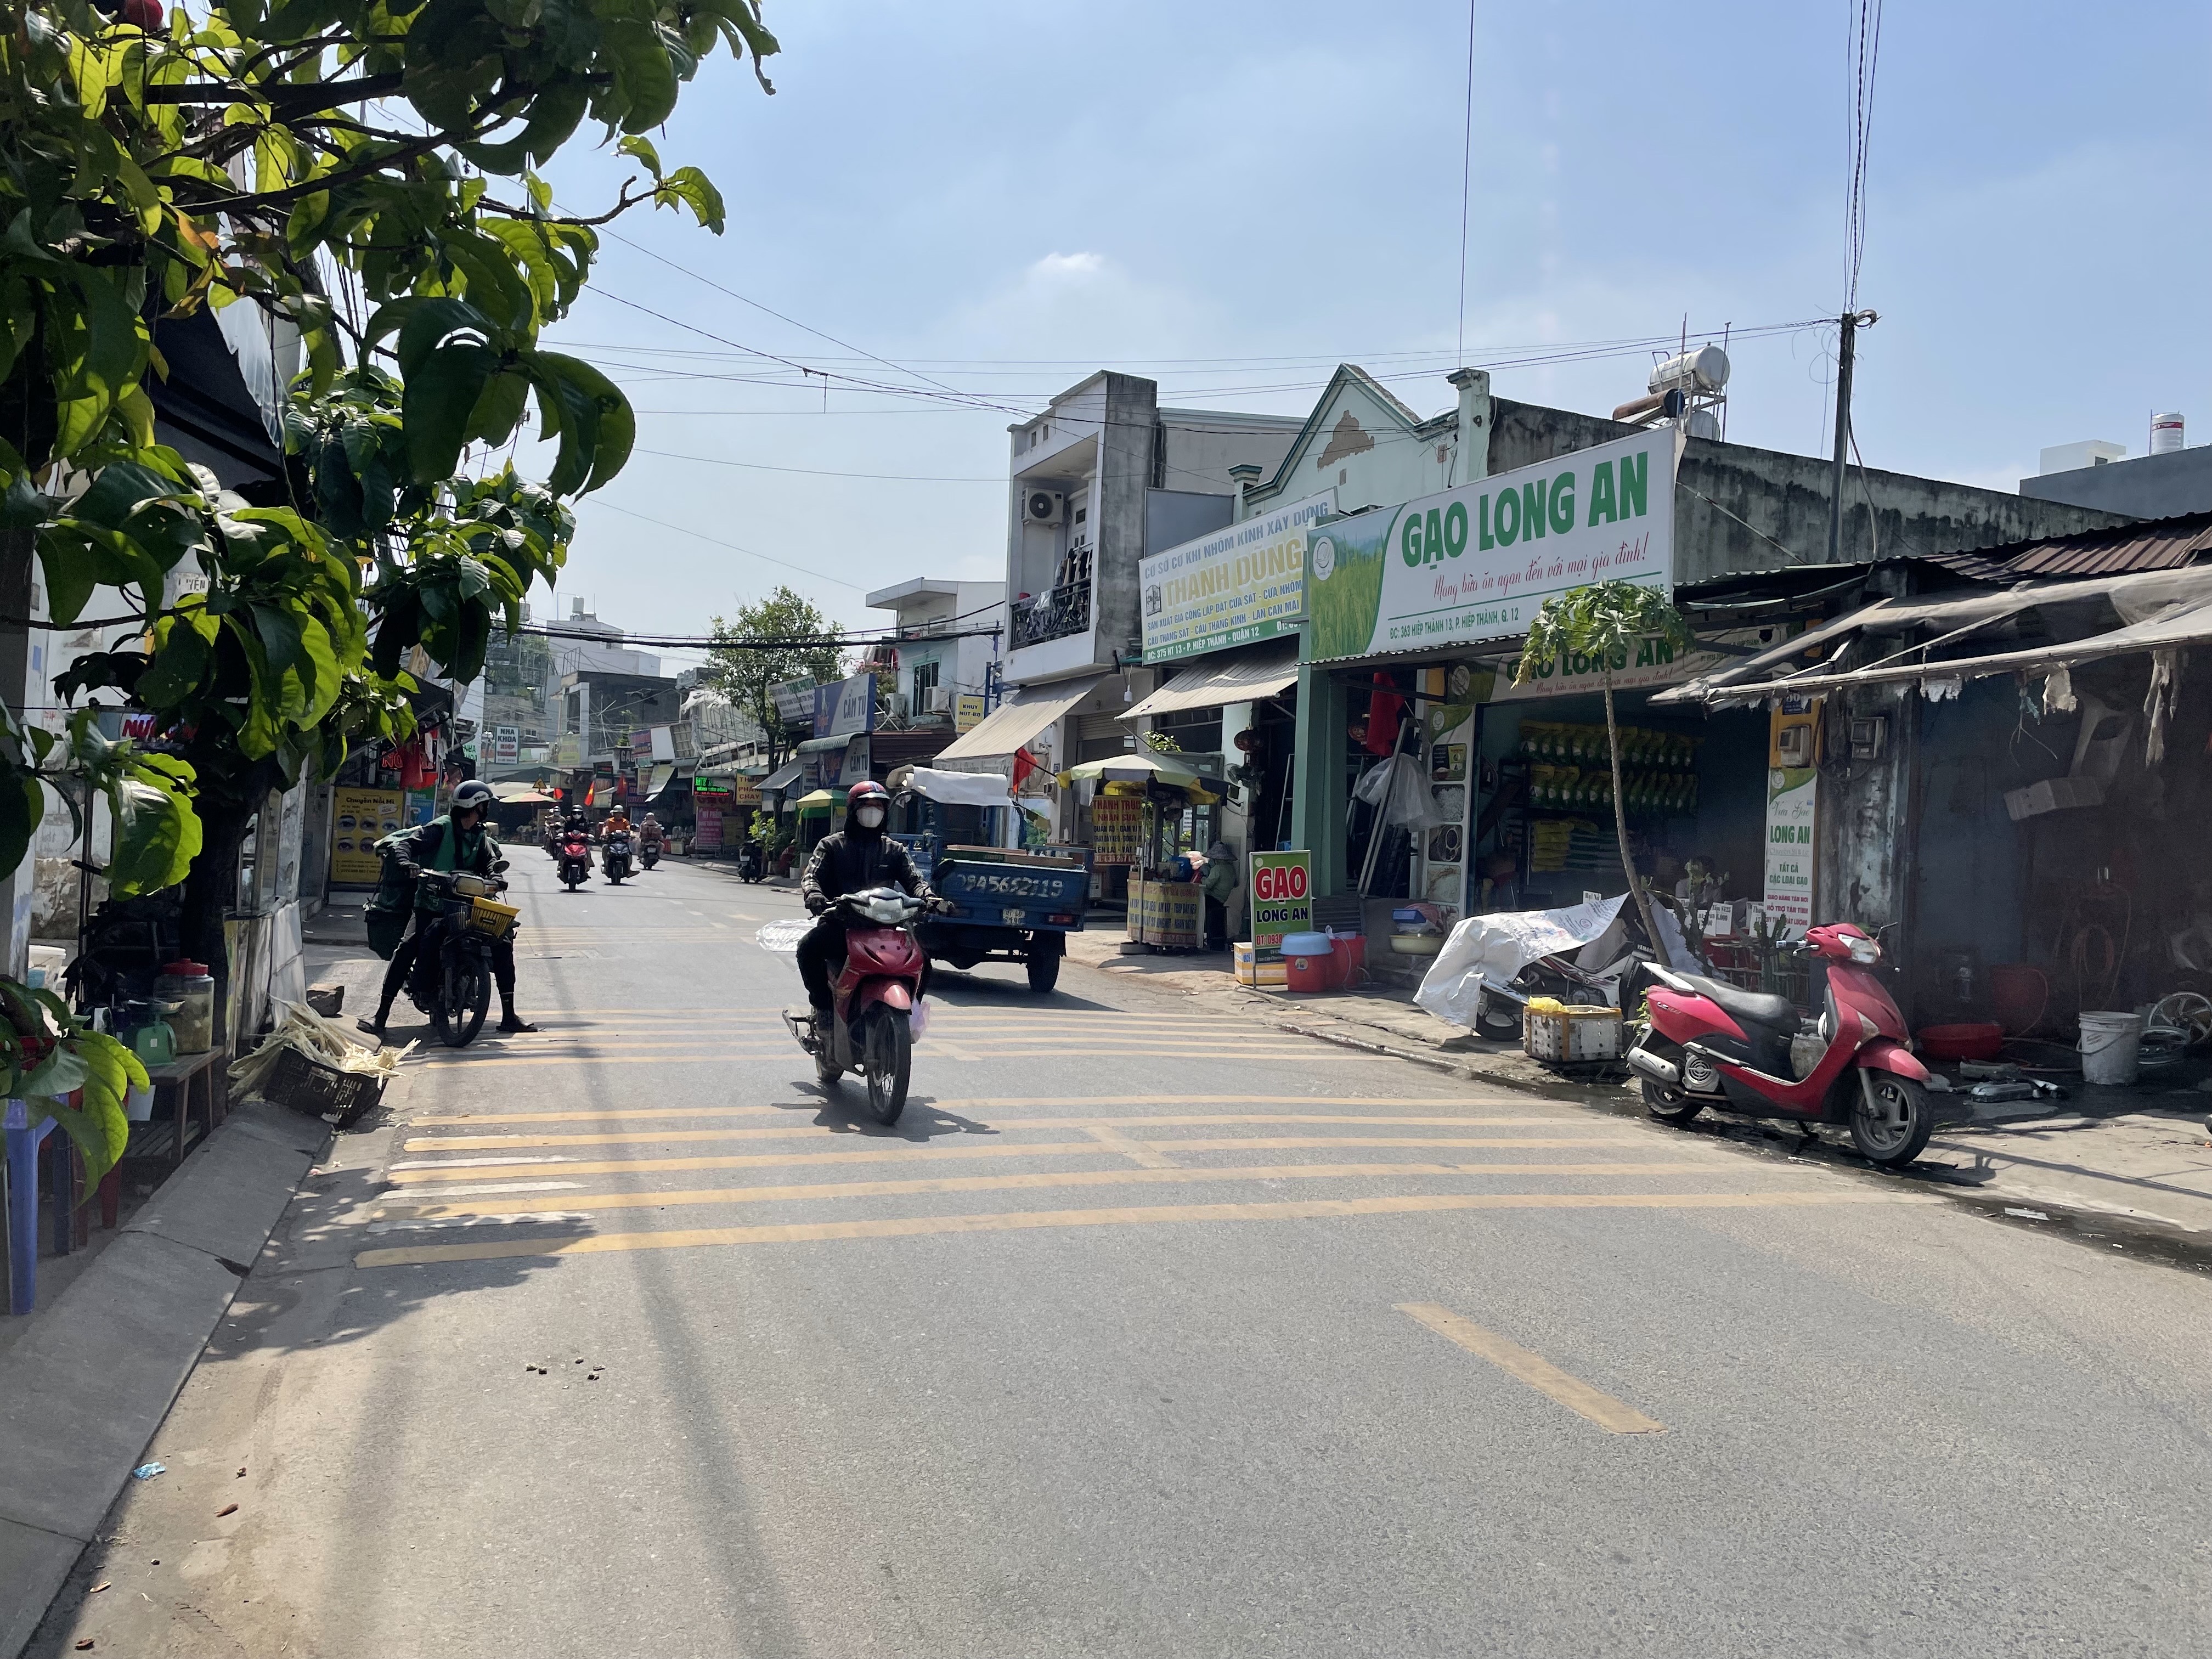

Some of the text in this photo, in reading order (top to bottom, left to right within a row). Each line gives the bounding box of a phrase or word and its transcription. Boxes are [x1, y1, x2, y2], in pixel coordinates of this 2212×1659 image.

[1402, 451, 1648, 569] GẠO LONG AN
[1145, 565, 1155, 579] CƠ
[1172, 552, 1183, 569] CƠ
[1186, 549, 1201, 565] KHÍ
[1204, 537, 1234, 558] NHÔM
[1237, 527, 1263, 547] KÍNH
[1267, 515, 1289, 537] XÂY
[1294, 502, 1328, 527] DỰNG
[1164, 538, 1302, 607] THANH DŨNG
[1482, 571, 1494, 589] ăn
[1498, 572, 1521, 596] ngon
[1525, 556, 1543, 582] đến
[1547, 556, 1564, 578] với
[1567, 554, 1588, 577] mọi
[1592, 551, 1610, 580] gia
[1615, 532, 1649, 565] đình!
[1280, 579, 1302, 595] NHÔM
[1160, 630, 1177, 644] THANG
[1208, 618, 1229, 631] THANG
[1252, 608, 1266, 620] LAN
[1268, 603, 1283, 617] CAN
[1401, 625, 1410, 637] 363
[1412, 619, 1423, 639] HIỆP
[1425, 617, 1443, 634] THÀNH
[1462, 611, 1475, 631] HIỆP
[1511, 607, 1519, 621] 12
[1167, 646, 1174, 656] HT
[1175, 645, 1182, 654] 13
[1251, 627, 1260, 637] 12
[1635, 639, 1673, 668] AN
[1093, 800, 1119, 810] THANH
[1770, 825, 1810, 844] LONG AN
[1255, 866, 1308, 904] GẠO
[1256, 907, 1308, 923] LONG AN
